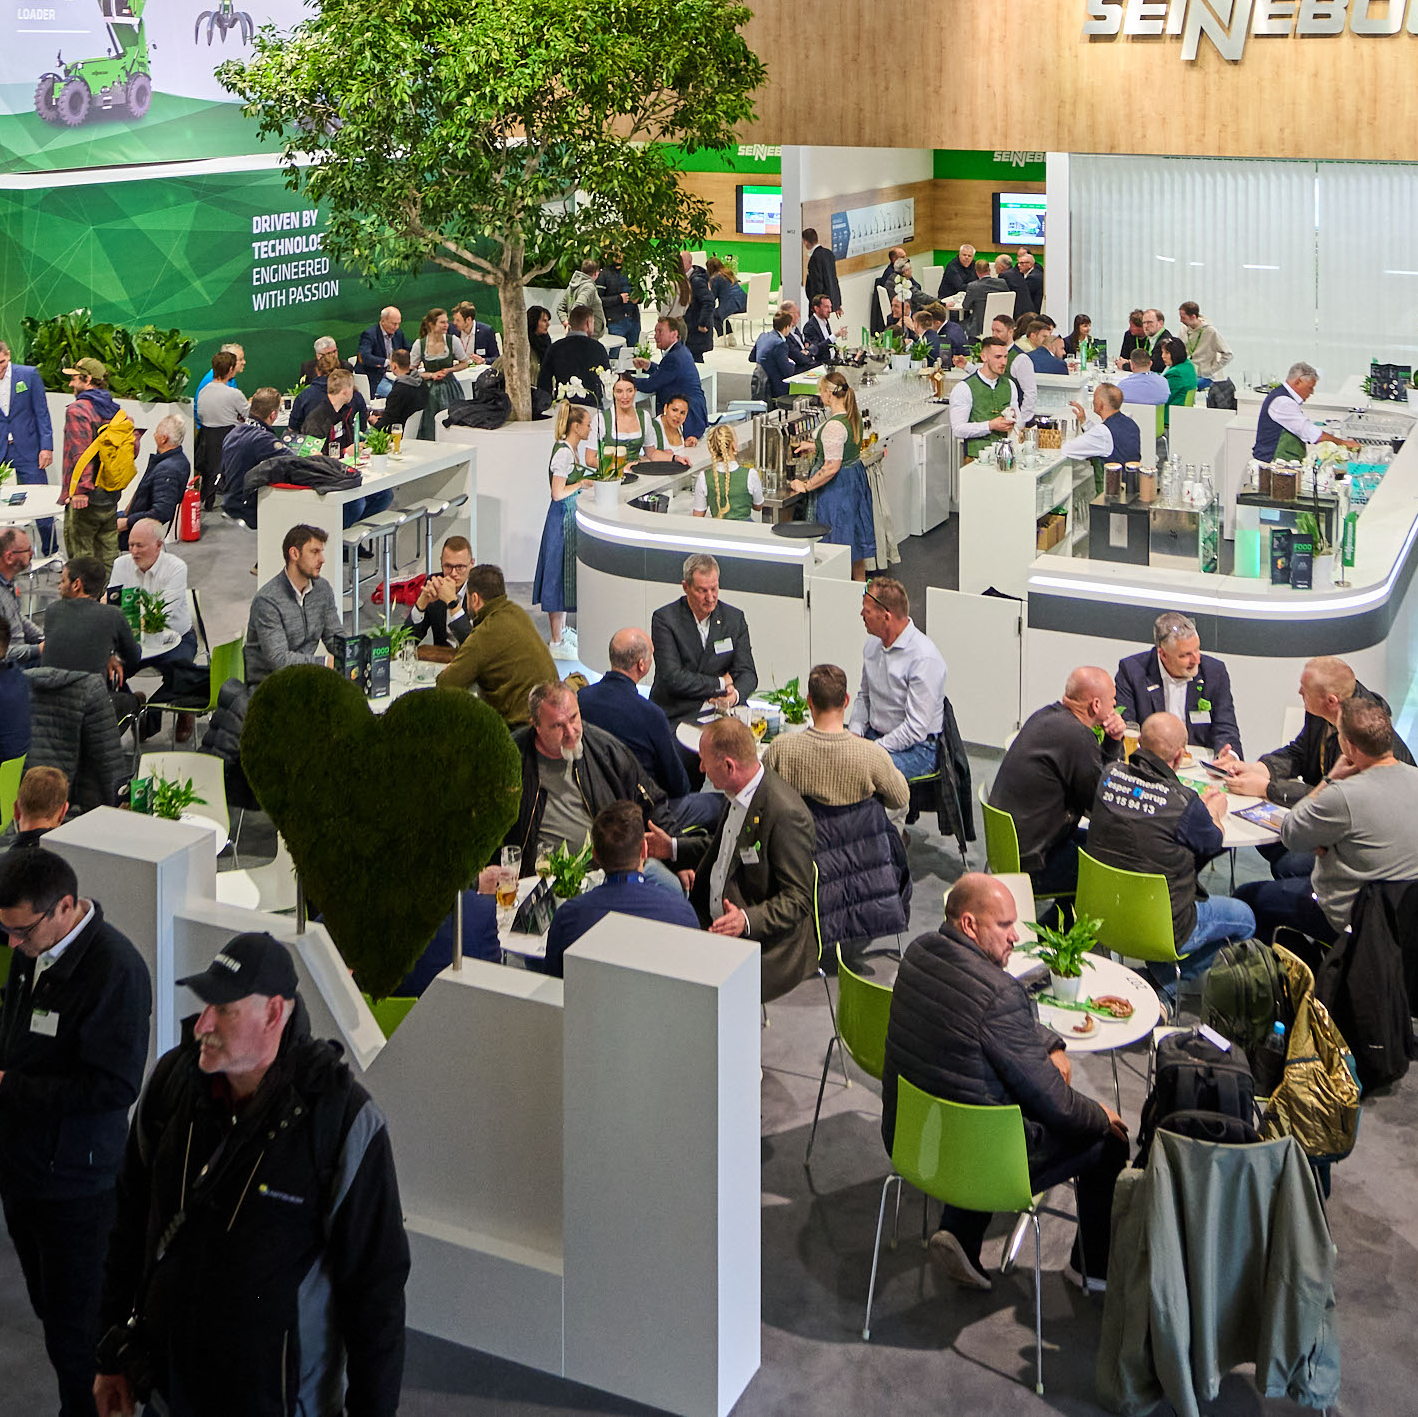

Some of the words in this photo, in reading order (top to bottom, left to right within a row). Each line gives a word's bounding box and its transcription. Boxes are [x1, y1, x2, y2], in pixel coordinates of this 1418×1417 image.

[17, 8, 56, 21] LOADER
[993, 151, 1046, 167] SENNEB
[252, 211, 300, 234] DRIVEN
[302, 209, 318, 228] BY
[252, 232, 328, 260] TECHNOLO
[252, 257, 330, 286] ENGINEERED
[252, 288, 286, 312] WITH
[289, 279, 339, 305] PASSION
[1293, 543, 1313, 551] FOOD
[1103, 791, 1115, 802] 20
[1116, 795, 1128, 807] 15
[1143, 803, 1156, 815] 13
